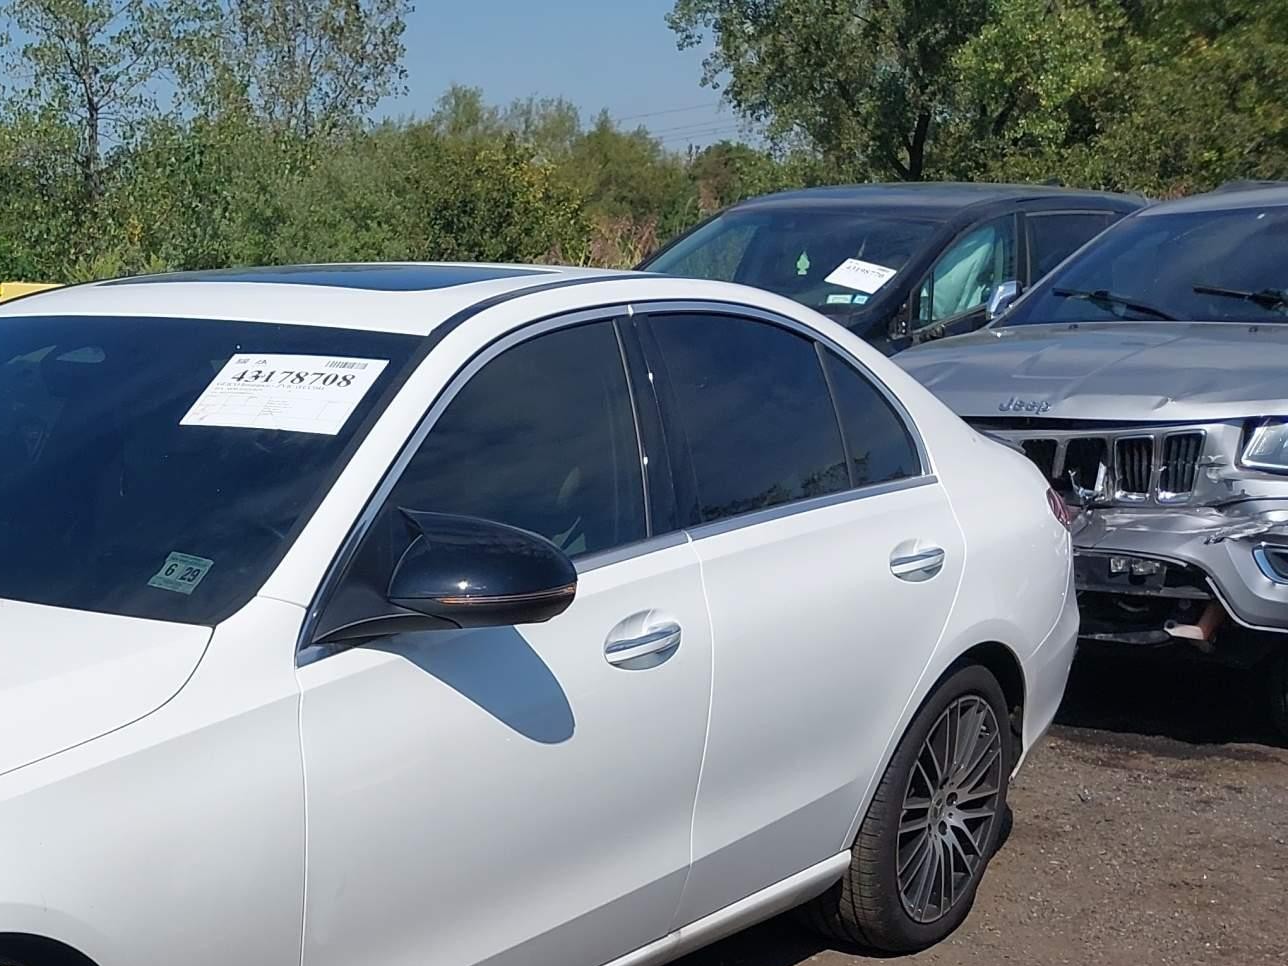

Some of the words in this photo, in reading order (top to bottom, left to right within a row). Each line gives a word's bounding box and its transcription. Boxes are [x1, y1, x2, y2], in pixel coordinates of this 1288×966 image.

[231, 369, 356, 388] 43178708
[998, 397, 1051, 415] Jeep
[164, 563, 179, 577] 6
[177, 566, 201, 582] 29
